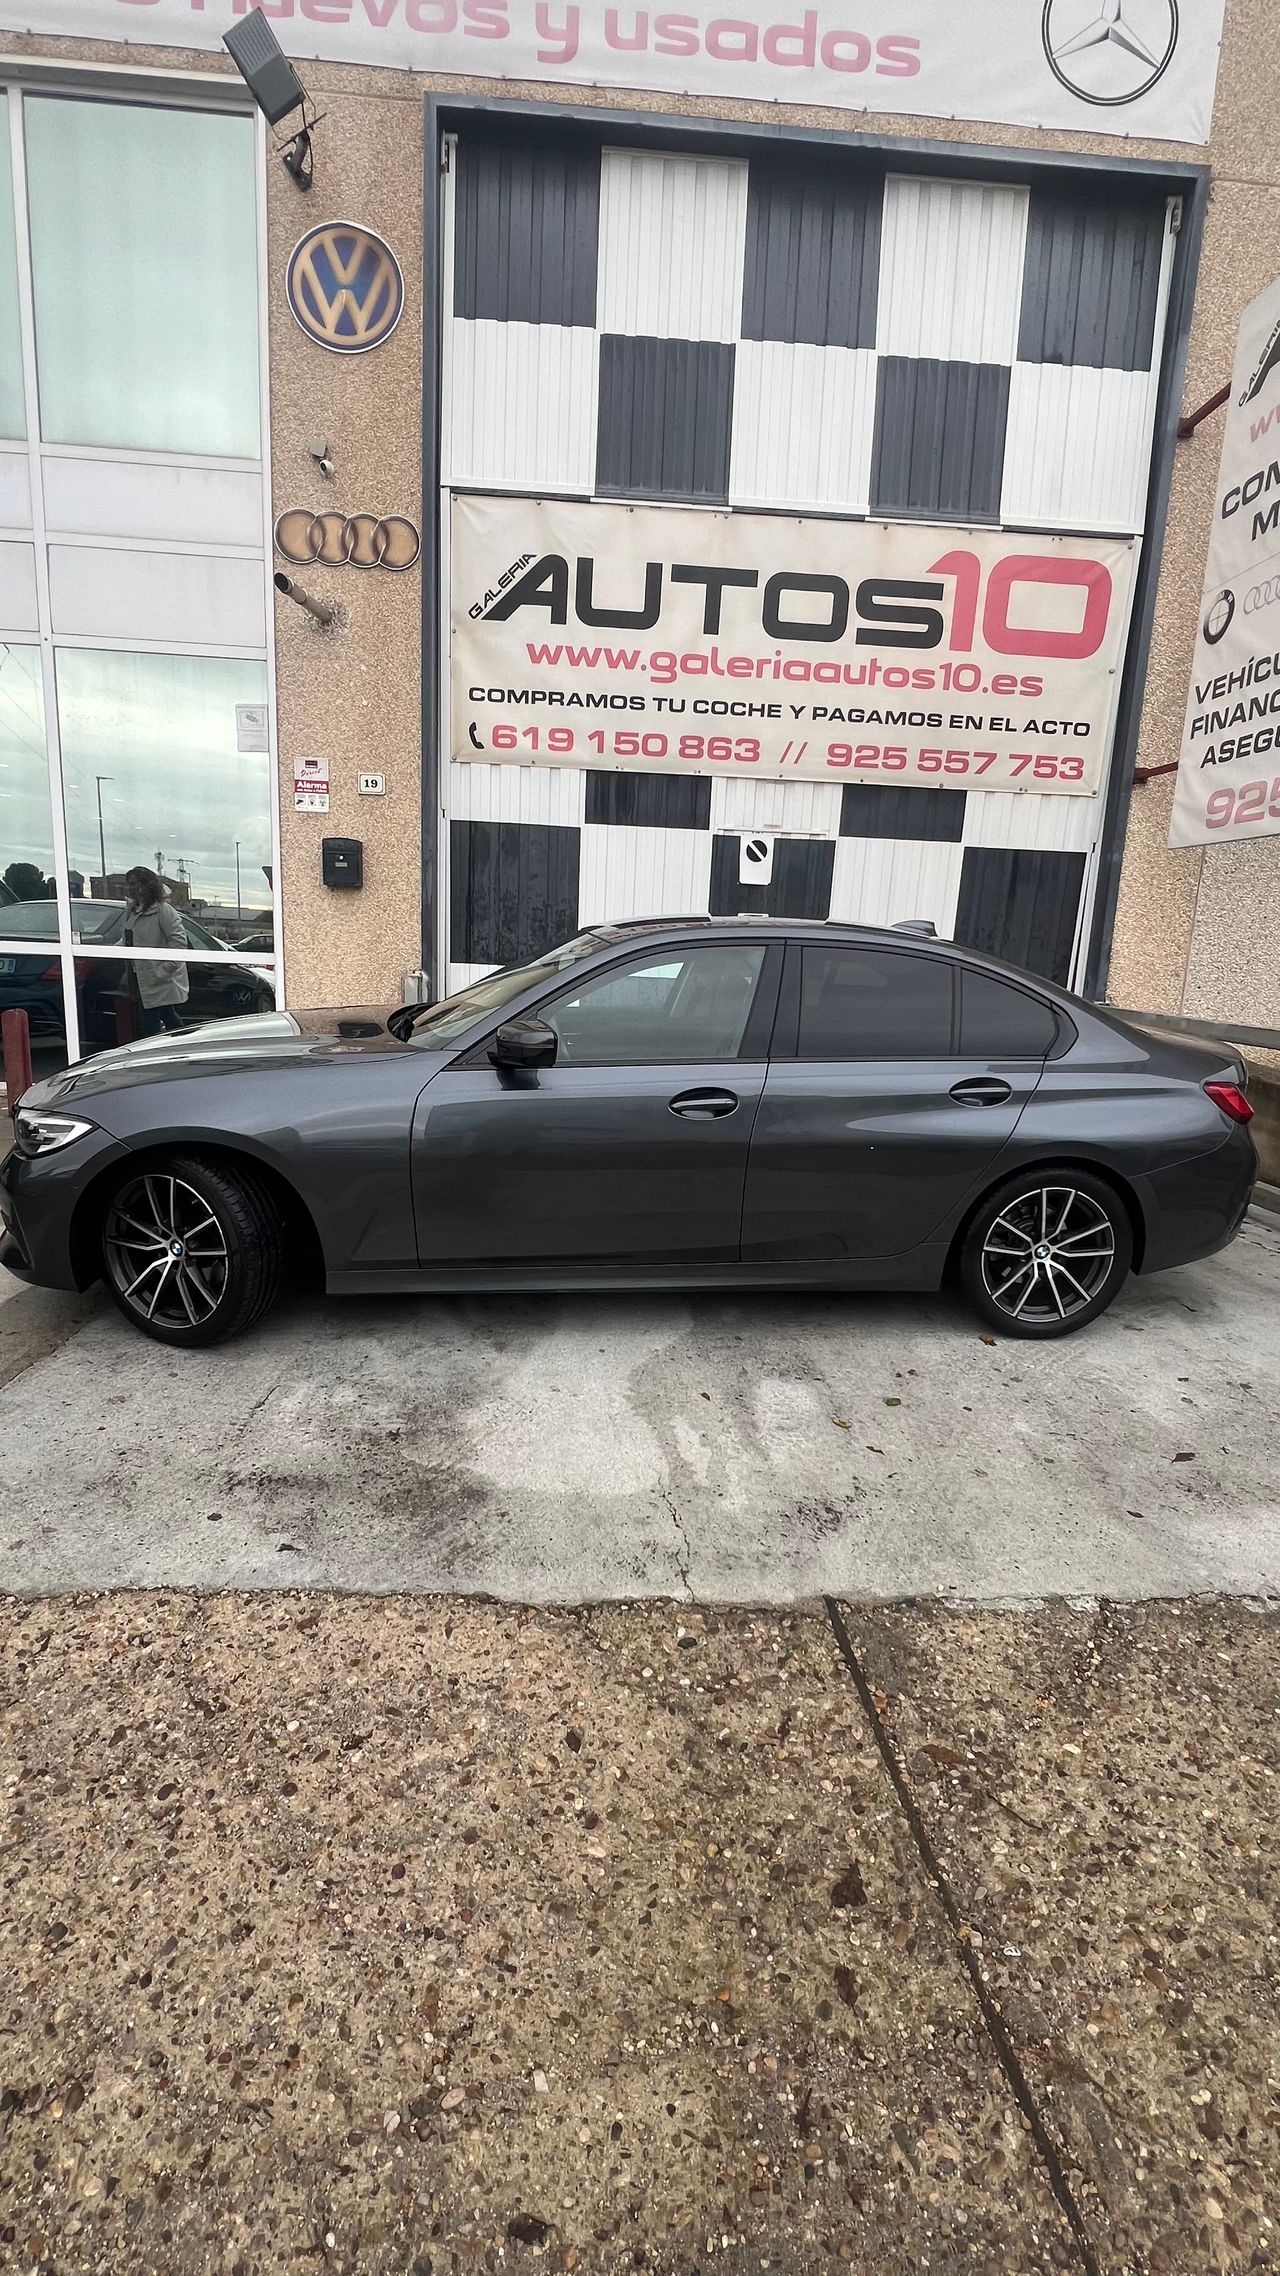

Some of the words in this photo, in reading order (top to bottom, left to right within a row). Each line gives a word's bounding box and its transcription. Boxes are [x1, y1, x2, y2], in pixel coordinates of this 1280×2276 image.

[190, 0, 511, 39] evos
[535, 2, 580, 64] y
[604, 9, 921, 78] usados
[468, 553, 537, 619] GALERIA
[526, 643, 1043, 697] www.galeriaautos10.es
[469, 687, 646, 711] COMPRAMOS
[652, 698, 686, 713] TU
[693, 700, 782, 719] COCHE
[789, 705, 806, 720] Y
[812, 707, 943, 728] PAGAMOS
[949, 715, 983, 731] EN
[989, 718, 1017, 733] EL
[1022, 720, 1091, 737] ACTO
[492, 725, 574, 752] 619
[588, 730, 668, 757] 150
[678, 735, 761, 762] 863
[827, 743, 908, 770] 925
[917, 749, 997, 775] 557
[1008, 753, 1085, 780] 753
[296, 781, 328, 789] Alarma
[364, 779, 378, 789] 19
